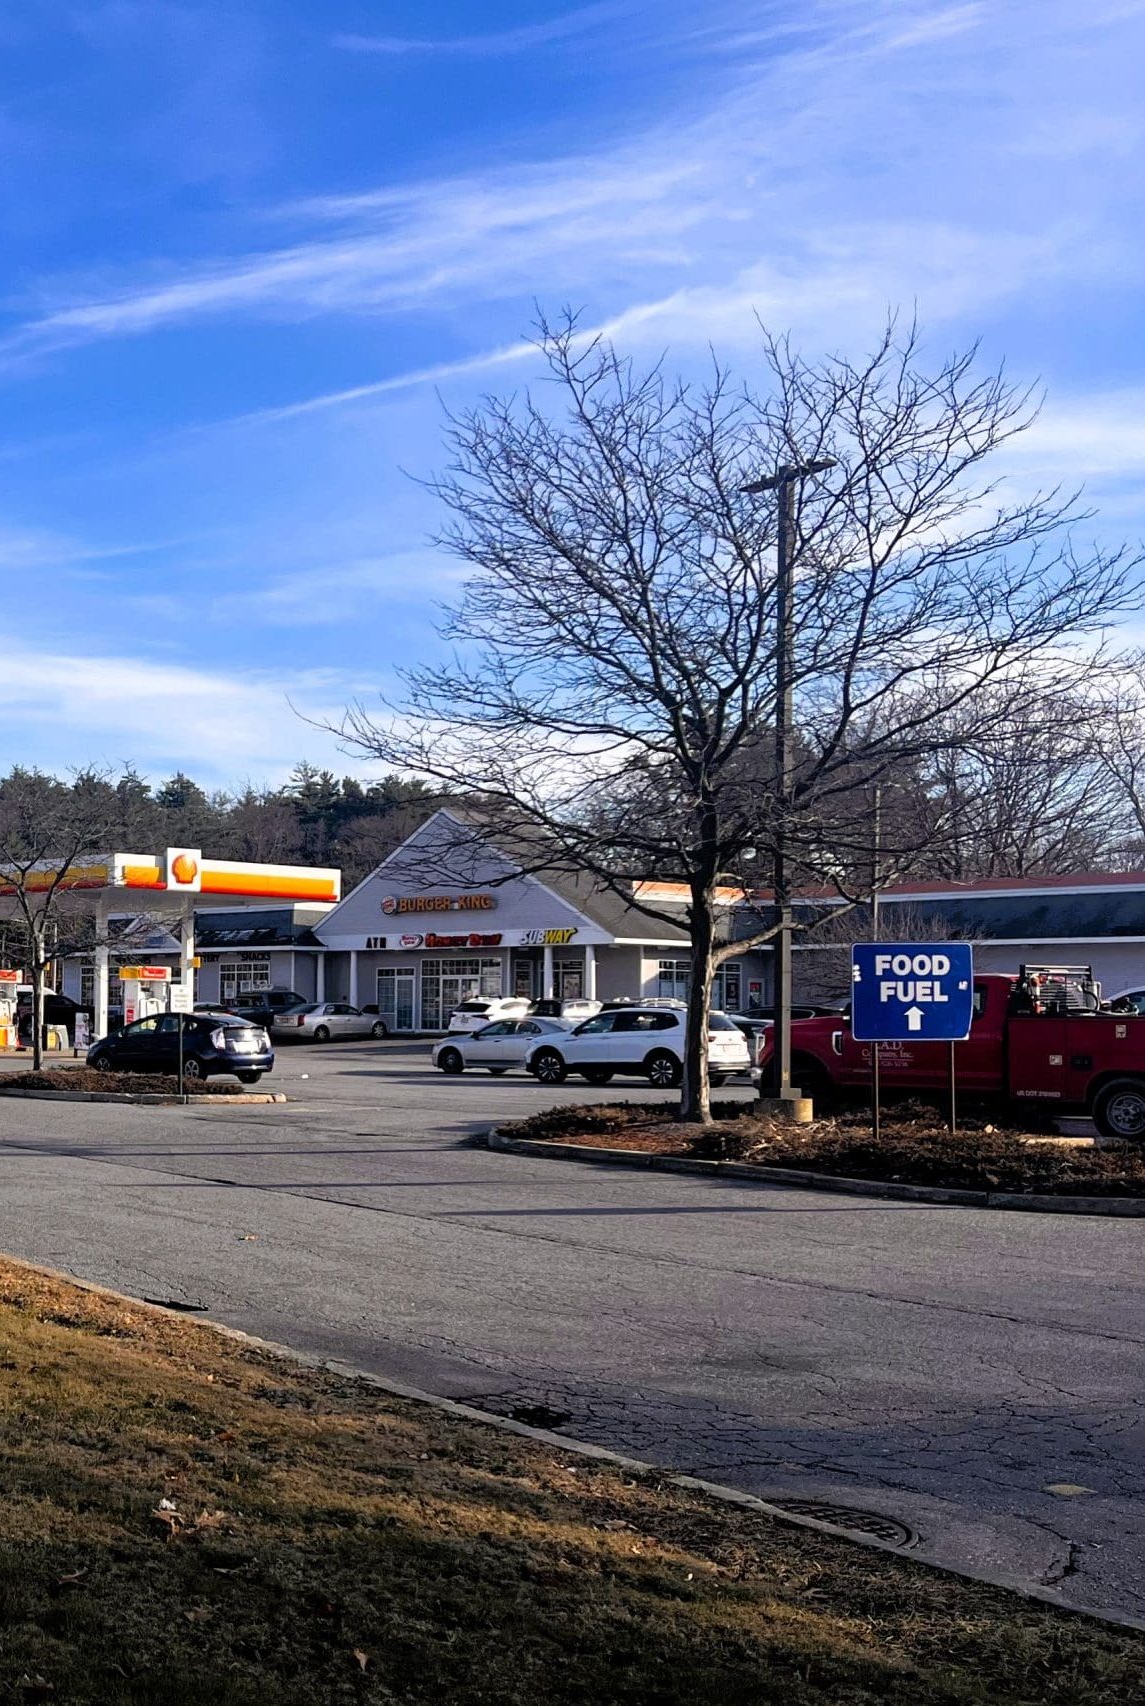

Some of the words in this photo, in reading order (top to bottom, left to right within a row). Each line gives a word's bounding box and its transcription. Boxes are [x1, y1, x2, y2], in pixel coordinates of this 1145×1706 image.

[399, 896, 452, 912] BURGER
[458, 894, 492, 910] KING
[366, 937, 387, 948] ATM
[519, 927, 578, 945] SUBWAY
[875, 954, 951, 976] FOOD
[880, 981, 949, 1002] FUEL
